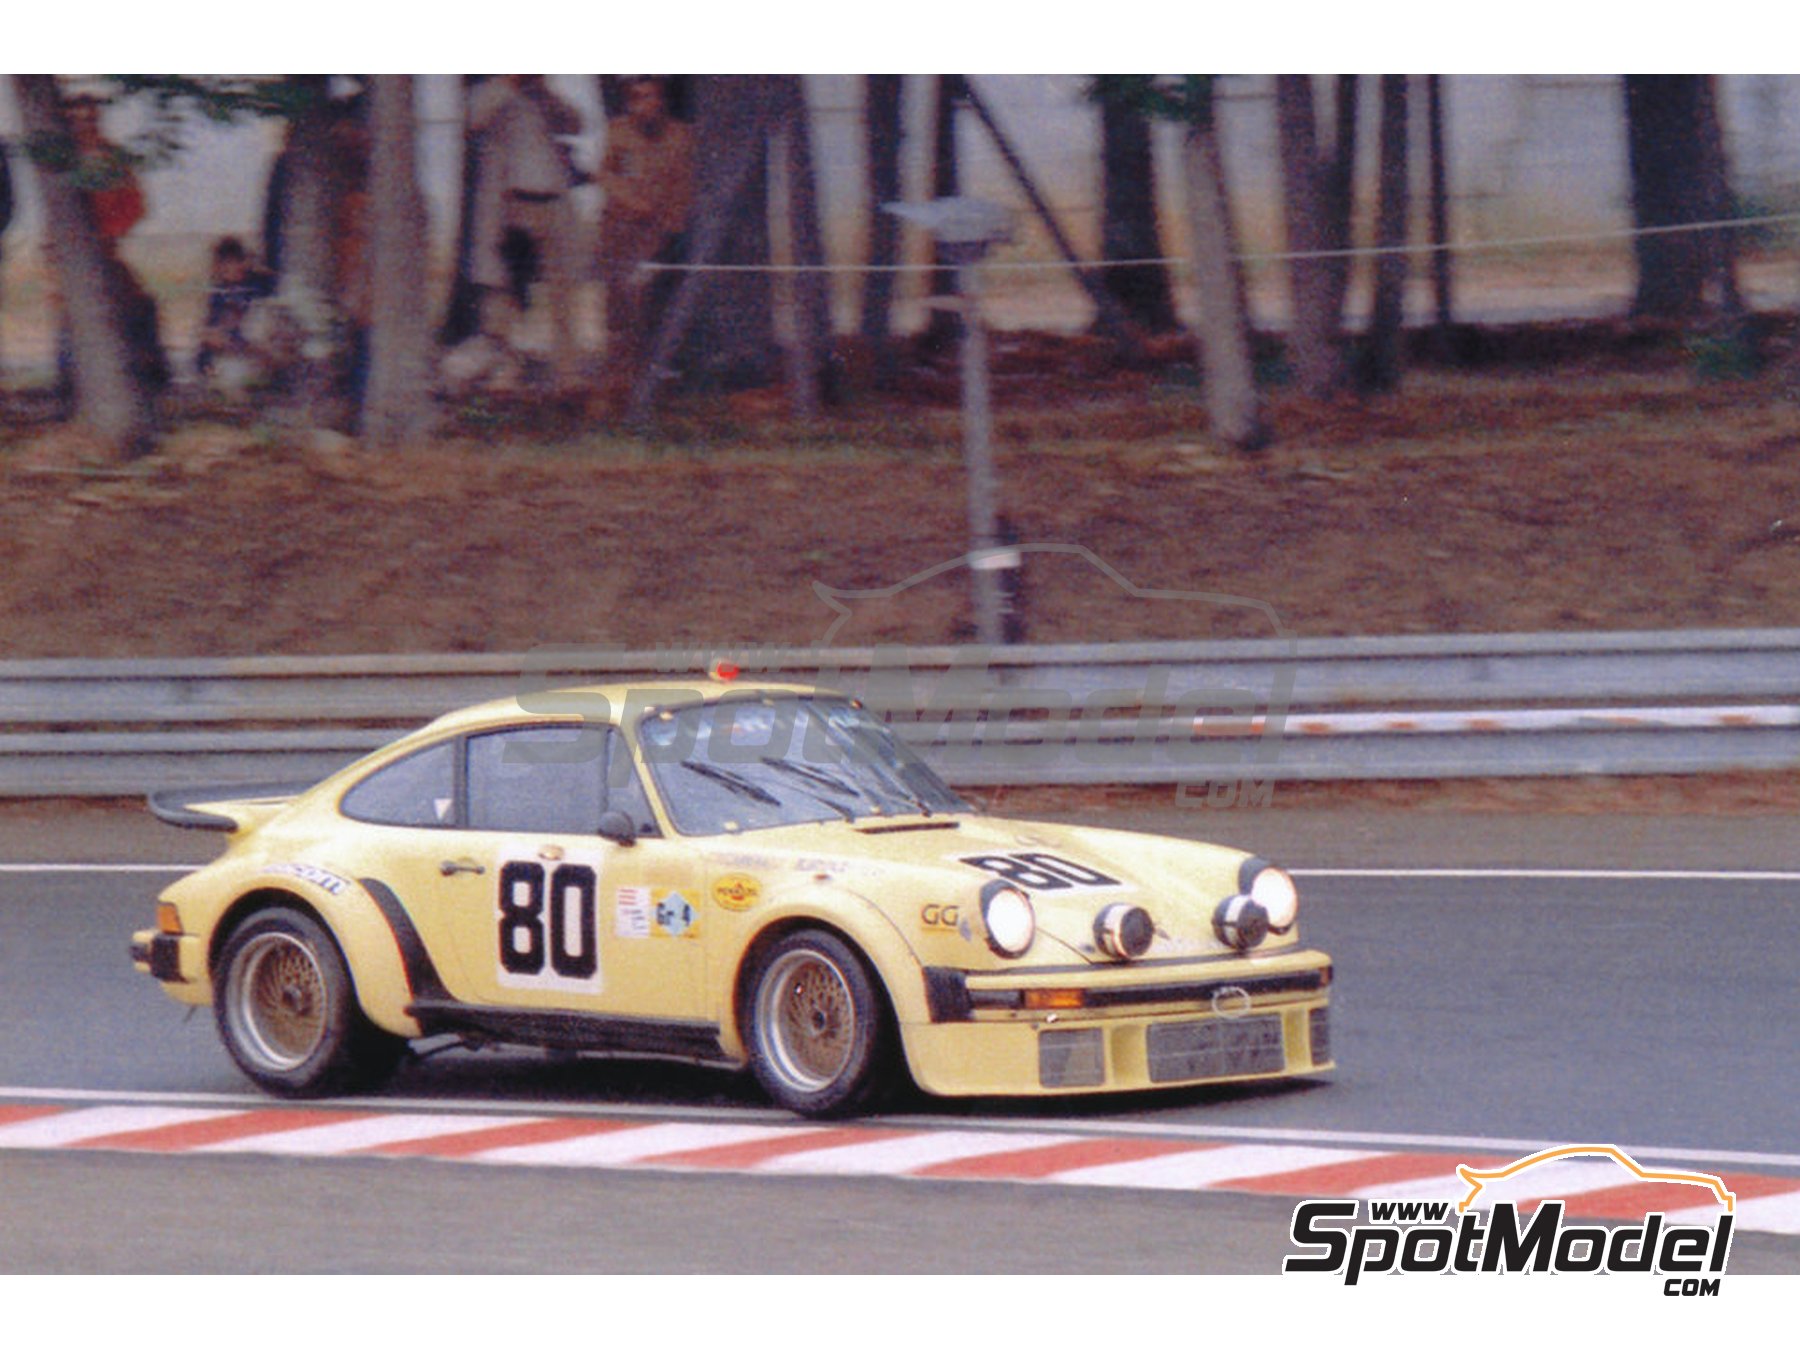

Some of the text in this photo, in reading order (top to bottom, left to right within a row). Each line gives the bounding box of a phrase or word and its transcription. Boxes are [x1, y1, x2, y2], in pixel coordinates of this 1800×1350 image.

[959, 853, 1122, 890] 80
[498, 860, 597, 979] 80
[921, 904, 960, 926] GG
